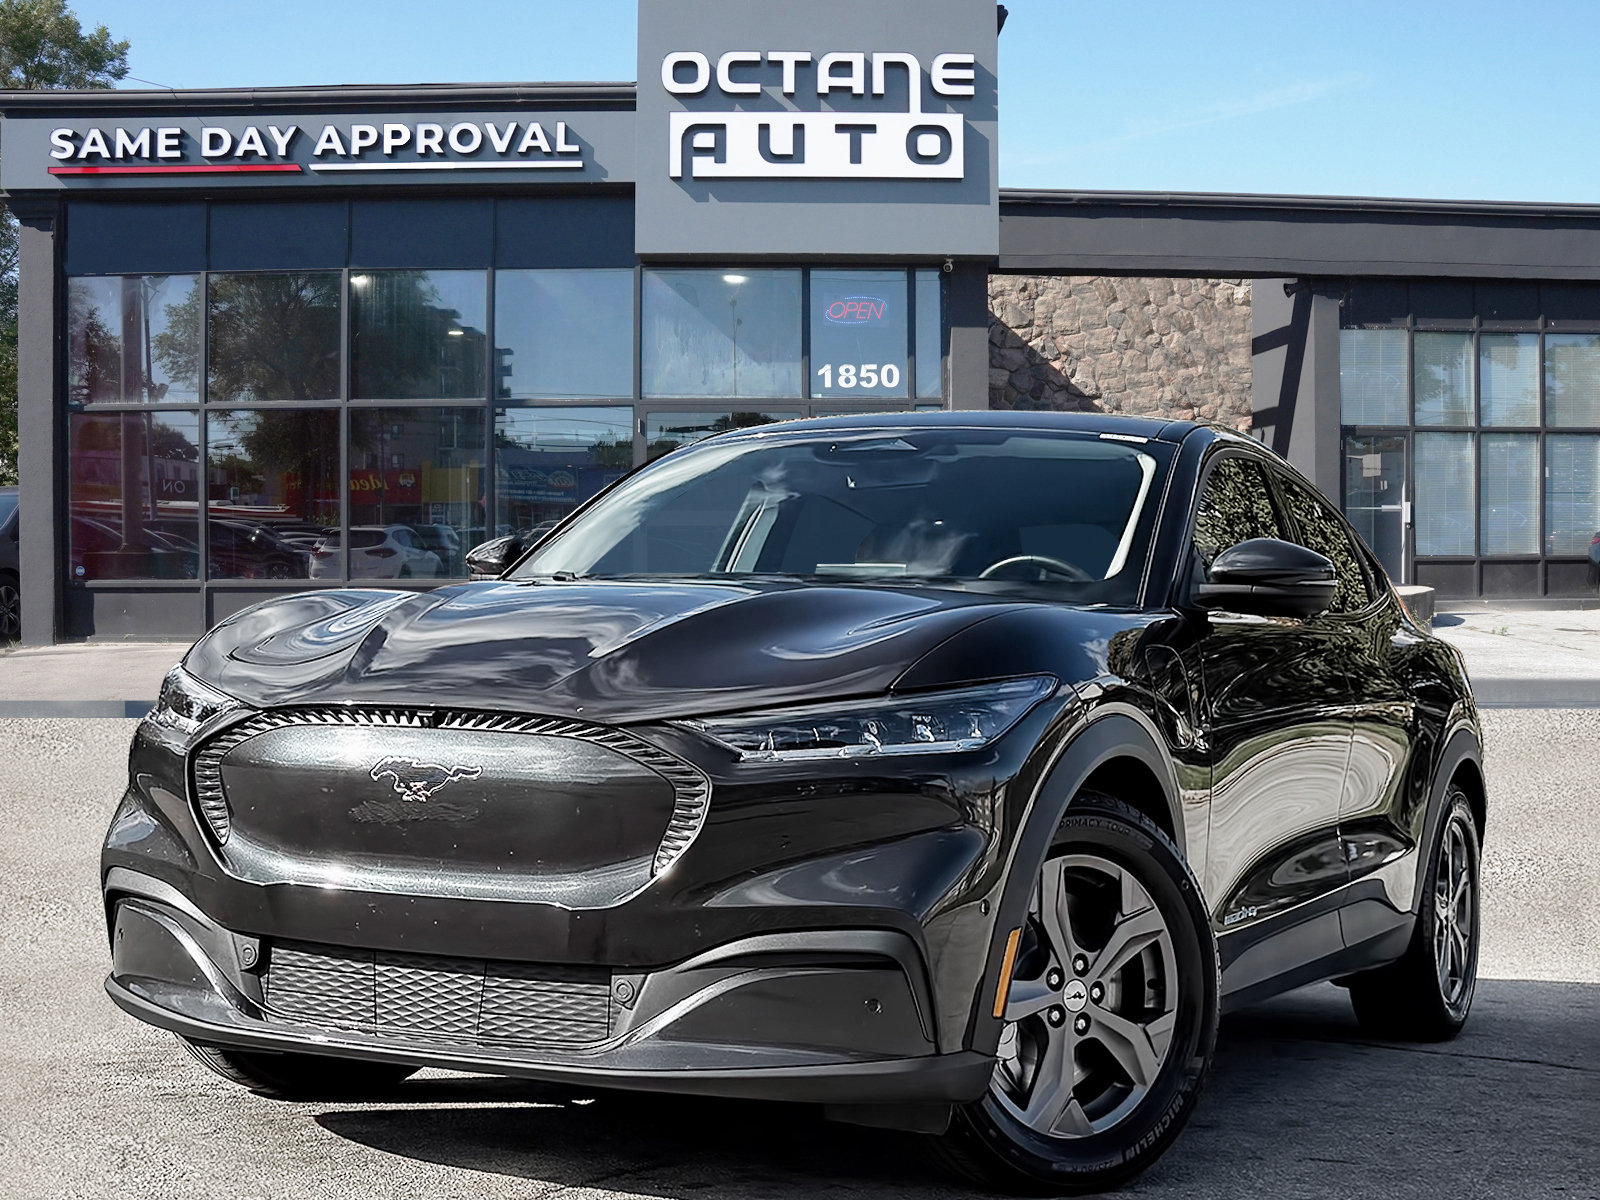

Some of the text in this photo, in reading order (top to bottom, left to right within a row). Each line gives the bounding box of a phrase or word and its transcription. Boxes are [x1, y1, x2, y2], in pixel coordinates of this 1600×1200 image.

[661, 51, 975, 112] OCTANE
[49, 121, 580, 160] SAME DAY APPROVAL
[681, 122, 952, 175] AUTO
[829, 302, 885, 319] OPEN
[817, 363, 900, 388] 1850
[1059, 818, 1131, 836] PRIMACY TOUR
[1125, 1093, 1184, 1161] MICHELIN
